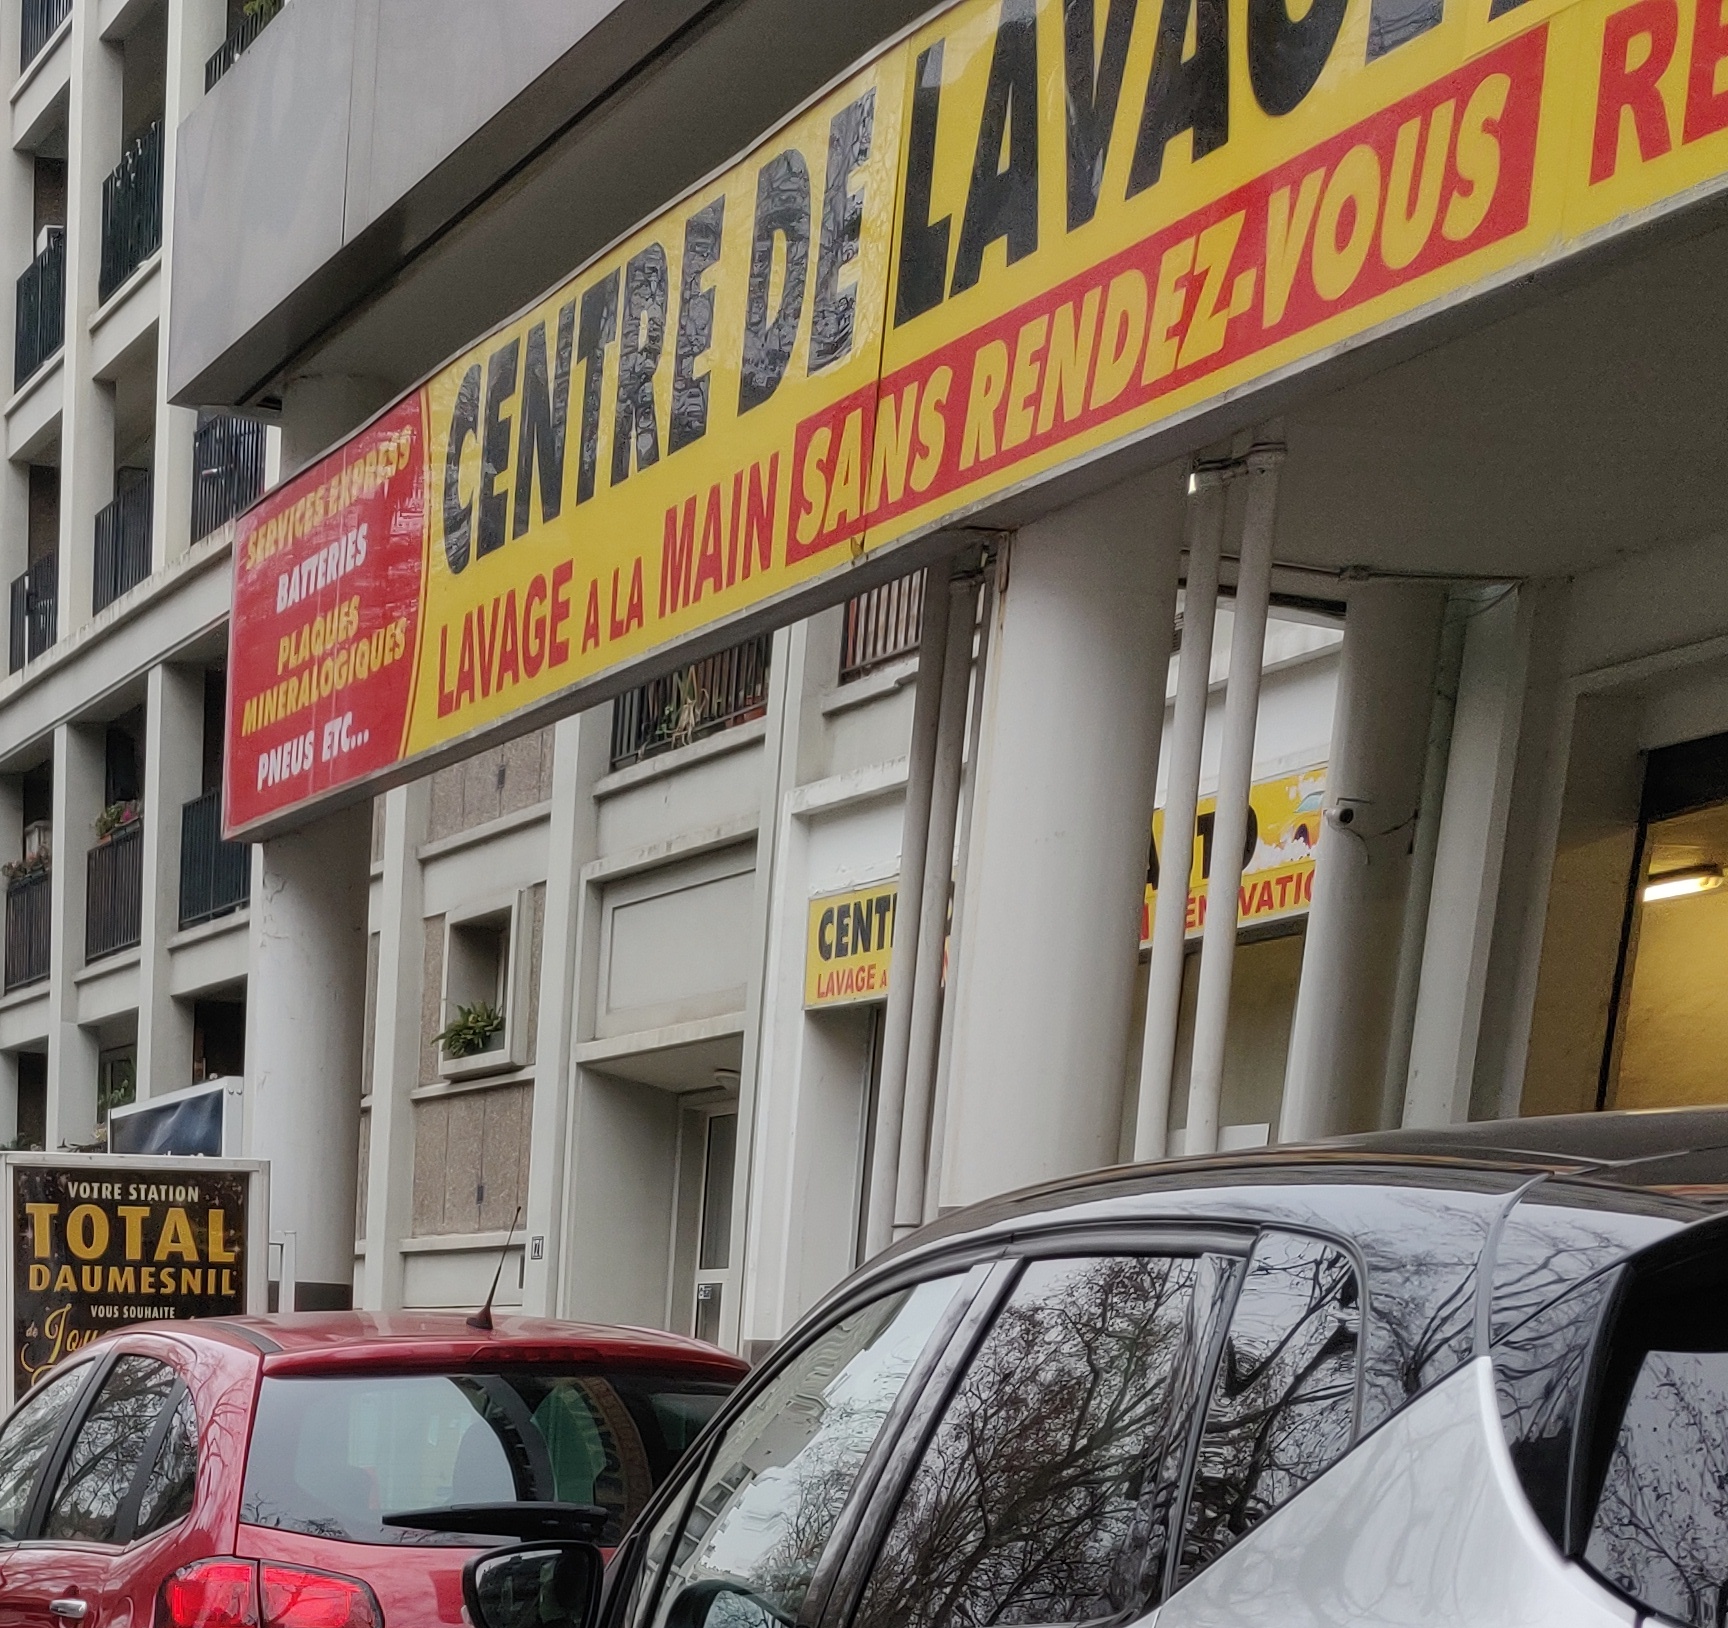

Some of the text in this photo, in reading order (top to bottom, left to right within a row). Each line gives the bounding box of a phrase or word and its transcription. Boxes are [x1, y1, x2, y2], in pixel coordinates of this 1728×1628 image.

[443, 0, 1443, 575] CENTRE DE LAVA
[437, 73, 1512, 719] LAVAGE A LA MAIN SANS RENDEZ-VOUS
[246, 484, 328, 570] SERVICES
[276, 523, 368, 614] BATTERIES
[278, 594, 360, 675] PLAQUES
[241, 617, 409, 738] MINERALOGIQUES
[257, 711, 369, 792] PNEUS ETC...
[817, 963, 877, 998] LAVAGE
[68, 1181, 199, 1202] VOTRE STATION
[25, 1202, 236, 1263] TOTAL
[29, 1264, 236, 1296] DAUMESNIL
[90, 1305, 175, 1319] VOUS SOUHAITE
[25, 1321, 39, 1338] de
